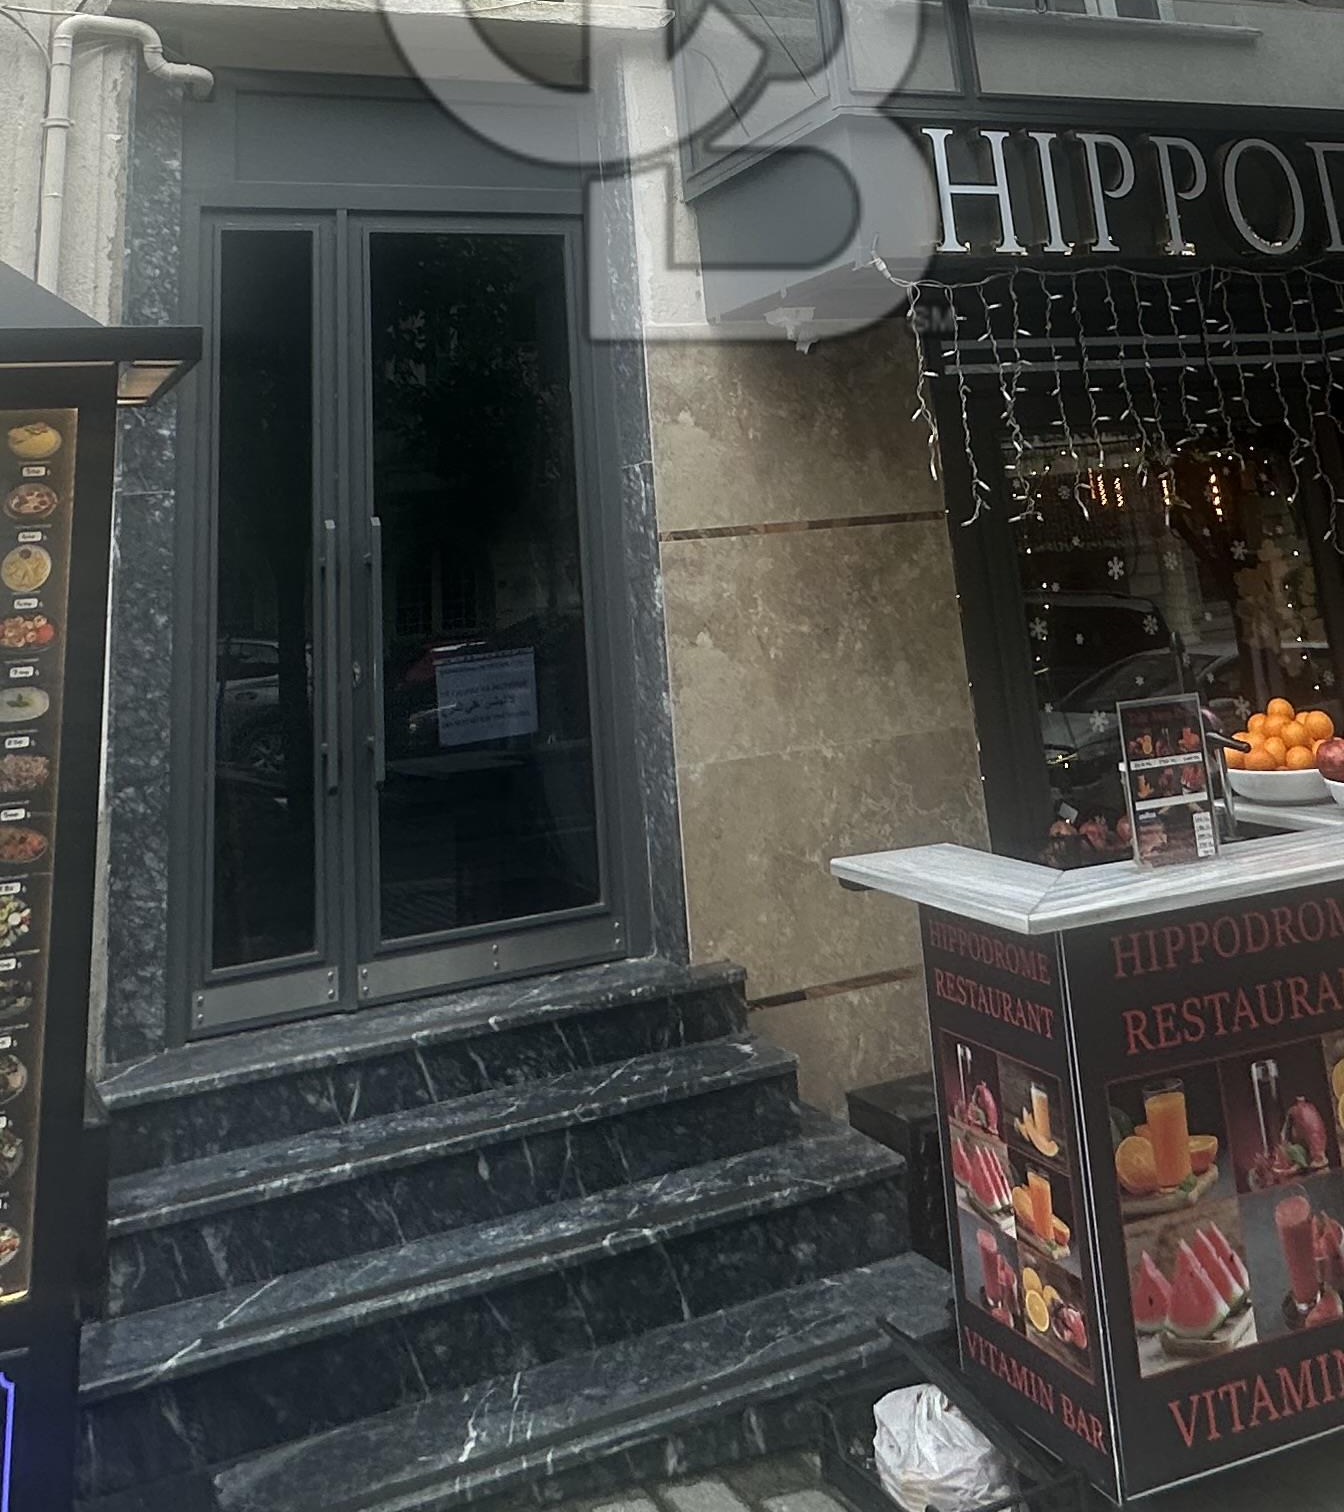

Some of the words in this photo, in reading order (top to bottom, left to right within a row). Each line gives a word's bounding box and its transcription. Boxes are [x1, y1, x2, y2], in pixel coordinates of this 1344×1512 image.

[928, 919, 1052, 986] HIPPODROME
[934, 968, 1054, 1040] RESTAURANT
[963, 1324, 1055, 1415] VITAMIN
[1060, 1393, 1109, 1456] BAR
